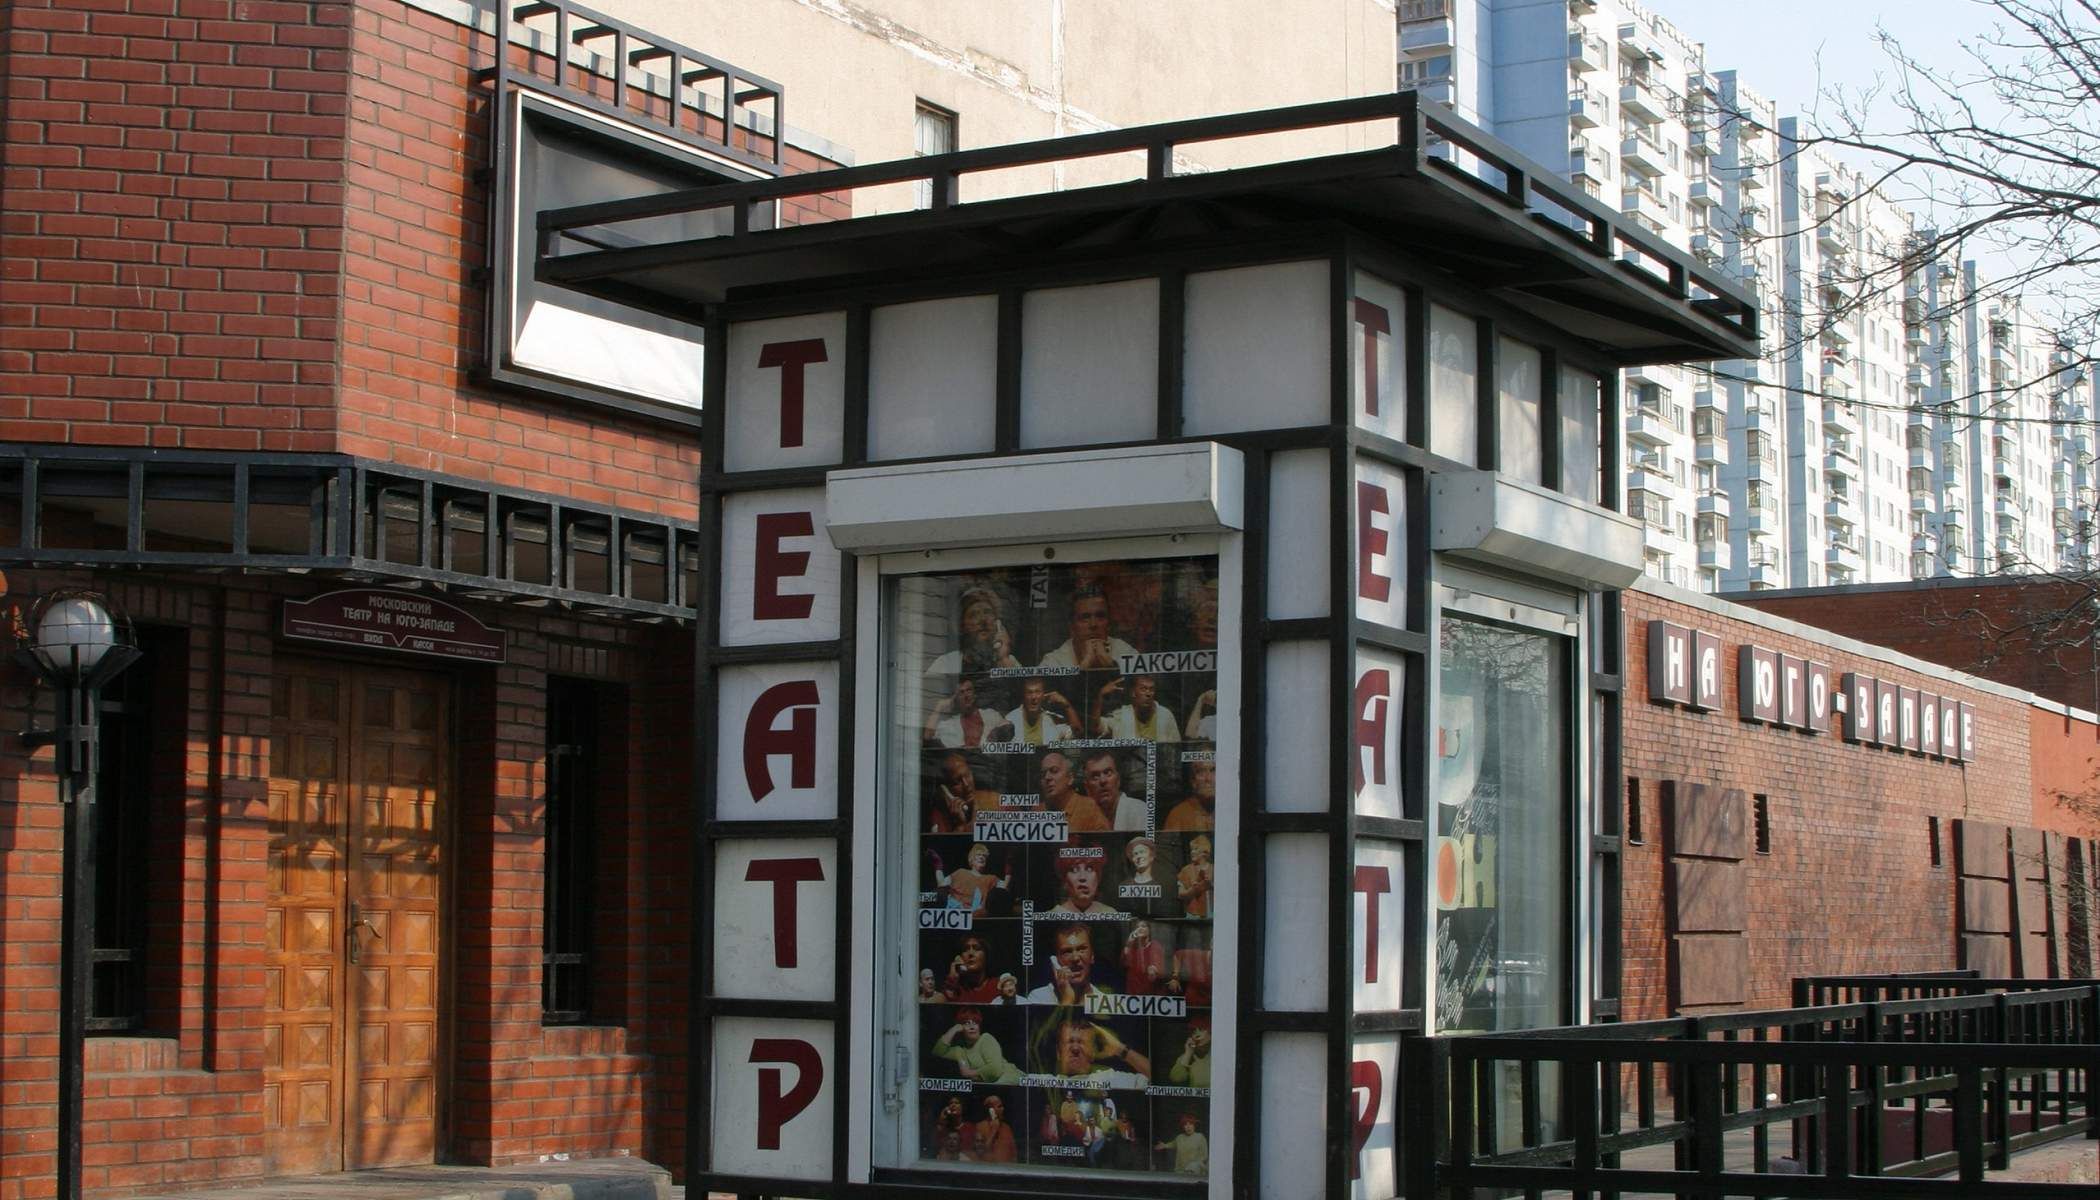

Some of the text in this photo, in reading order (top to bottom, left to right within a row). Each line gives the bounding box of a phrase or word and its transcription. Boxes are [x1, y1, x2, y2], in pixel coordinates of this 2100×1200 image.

[368, 595, 432, 615] МОСКОВСКИЙ
[343, 607, 456, 632] ТЕАТР НА ЮГО-ЗАПАДЕ
[412, 639, 434, 651] КАССА
[1121, 651, 1217, 674] ТАКСИСТ
[991, 666, 1079, 678] СЛИШКОМ ЖЕНАТЫЙ
[1668, 635, 1972, 752] НА ЮГО-ЗАПАДЕ
[744, 337, 828, 1151] ТЕАТР
[1049, 740, 1090, 748] ПРЕМЬЕРА
[1350, 296, 1391, 1181] ТЕАТР
[982, 742, 1035, 753] КОМЕДИЯ
[1001, 794, 1038, 806] Р.КУНИ
[976, 811, 1065, 821] СЛИШКОМ ЖЕНАТЫЙ
[976, 823, 1067, 840] ТАКСИСТ
[1060, 848, 1103, 858] КОМЕДИЯ
[1120, 886, 1160, 897] Р.КУНИ
[919, 909, 972, 928] СИСТ
[1033, 912, 1075, 921] ПРЕМЬЕРА
[1024, 901, 1032, 964] КОМЕДИЯ
[1087, 996, 1185, 1015] ТАКСИСТ
[919, 1079, 972, 1091] КОМЕДИЯ
[1021, 1077, 1111, 1090] СЛИШКОМ ЖЕНАТЫЙ
[1145, 1086, 1193, 1097] СЛИШКОМ
[1042, 1145, 1085, 1156] КОМЕДИЯ
